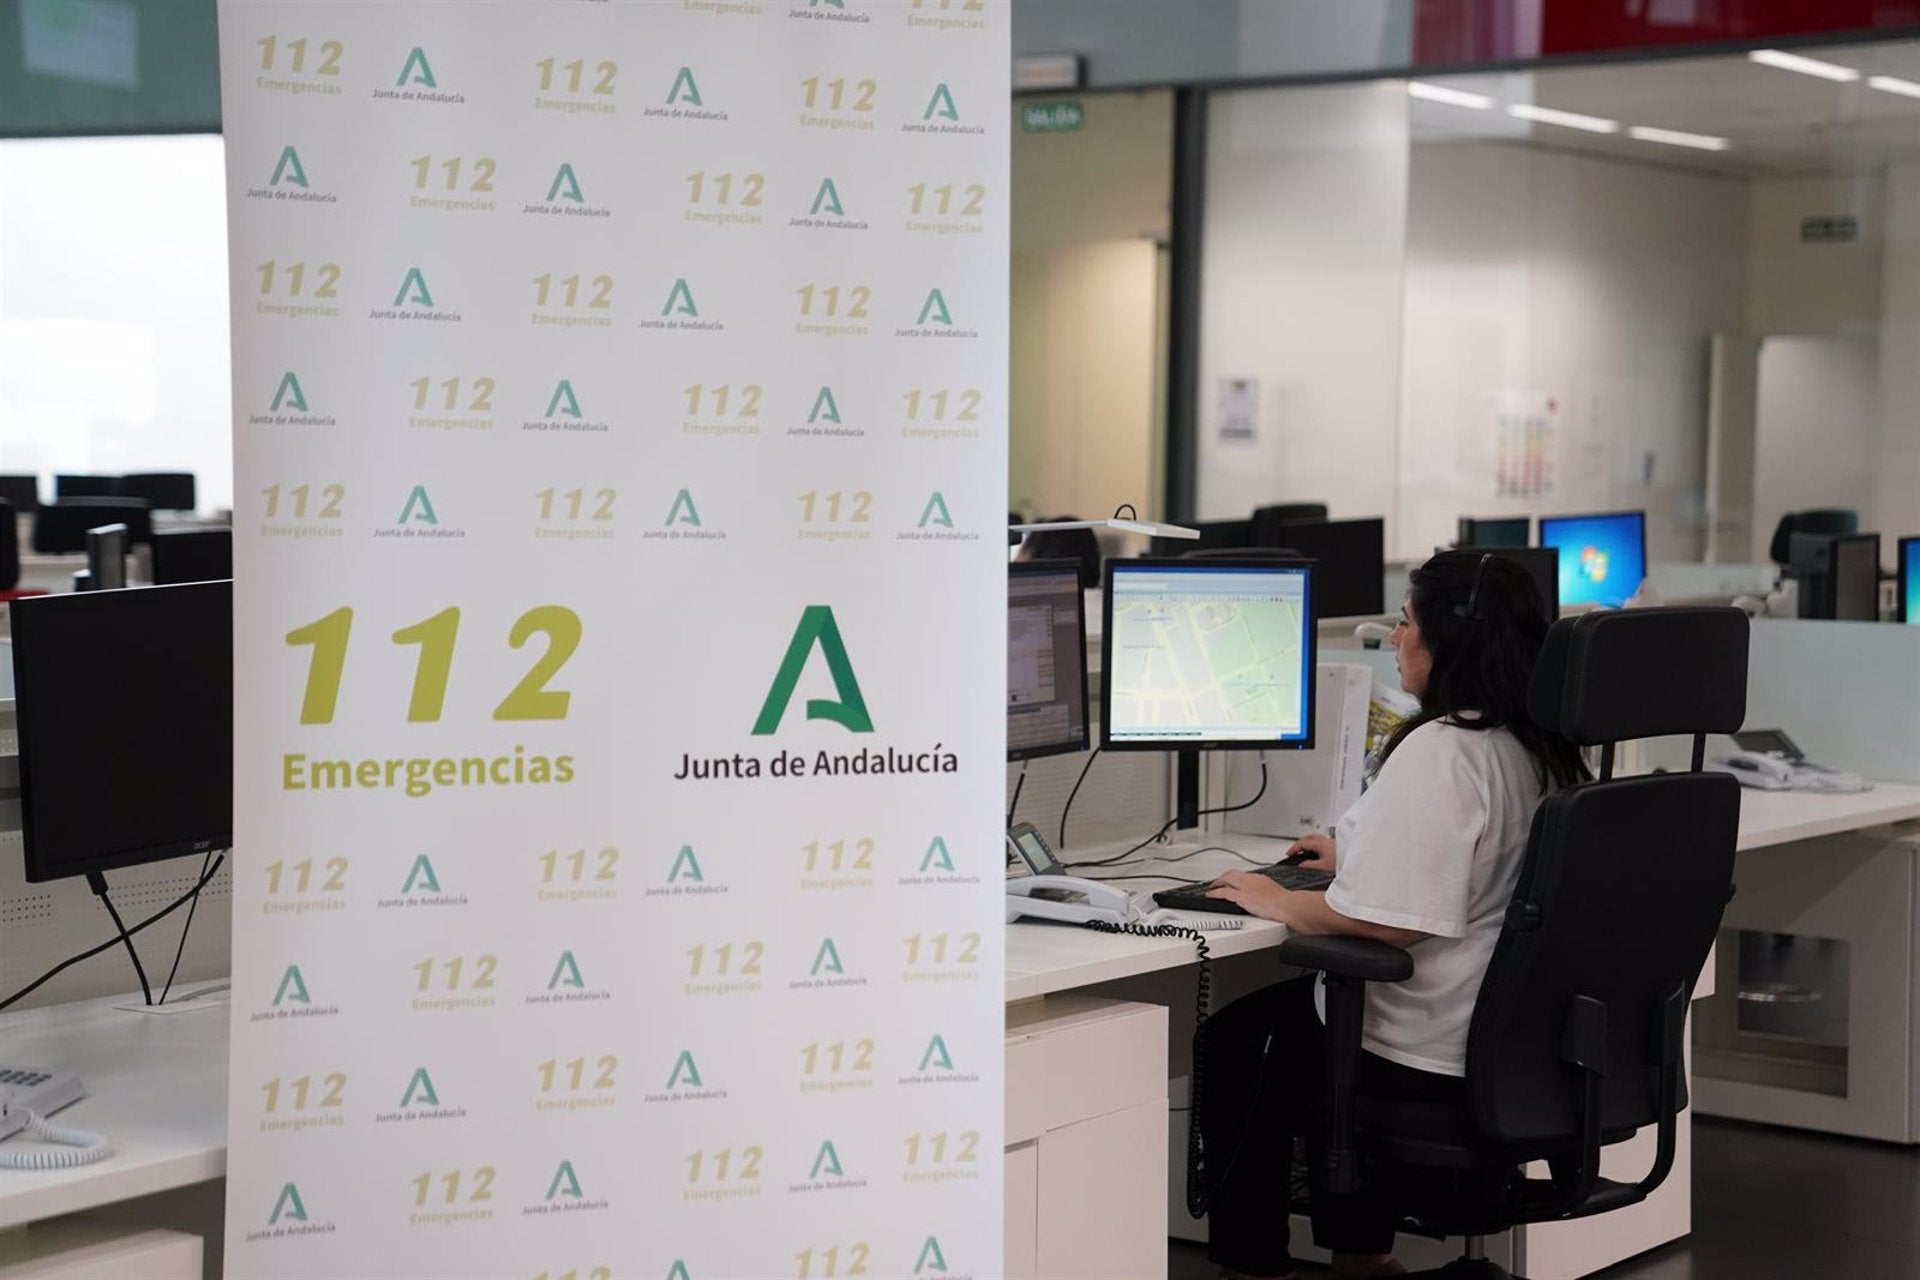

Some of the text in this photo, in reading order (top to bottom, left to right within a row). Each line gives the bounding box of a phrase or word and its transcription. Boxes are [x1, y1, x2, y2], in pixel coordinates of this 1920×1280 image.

[788, 10, 812, 19] Junta
[814, 11, 824, 19] de
[907, 15, 984, 30] Emergencias
[256, 35, 344, 75] 112
[535, 58, 618, 95] 112
[257, 77, 342, 95] Emergencias
[373, 89, 399, 99] Junta
[401, 90, 414, 100] de
[801, 77, 877, 111] 112
[535, 98, 616, 114] Emergencias
[644, 108, 668, 117] Junta
[670, 109, 681, 118] de
[800, 115, 874, 131] Emergencias
[902, 124, 925, 132] Junta
[928, 124, 938, 133] de
[411, 156, 497, 192] 112
[247, 189, 272, 199] Junta
[275, 190, 287, 200] de
[686, 171, 765, 205] 112
[411, 197, 495, 212] Emergencias
[908, 184, 985, 215] 112
[523, 205, 549, 214] Junta
[551, 206, 562, 214] de
[684, 210, 762, 225] Emergencias
[789, 218, 812, 227] Junta
[815, 219, 824, 227] de
[906, 221, 983, 234] Emergencias
[258, 261, 341, 297] 112
[532, 274, 613, 308] 112
[797, 285, 871, 318] 112
[257, 303, 339, 317] Emergencias
[370, 310, 396, 319] Junta
[398, 311, 411, 319] de
[532, 314, 612, 327] Emergencias
[639, 320, 664, 329] Junta
[667, 320, 677, 329] de
[796, 324, 868, 337] Emergencias
[922, 329, 931, 337] de
[410, 377, 495, 410] 112
[684, 384, 763, 417] 112
[903, 389, 982, 420] 112
[249, 415, 274, 424] Junta
[277, 416, 287, 425] de
[409, 417, 493, 430] Emergencias
[522, 422, 547, 430] Junta
[550, 422, 560, 431] de
[683, 423, 759, 436] Emergencias
[813, 428, 821, 436] de
[902, 426, 979, 440] Emergencias
[262, 484, 345, 517] 112
[535, 488, 617, 520] 112
[798, 491, 872, 522] 112
[262, 526, 343, 539] Emergencias
[374, 529, 401, 537] Junta
[404, 529, 415, 537] de
[535, 527, 614, 540] Emergencias
[669, 531, 680, 539] de
[798, 528, 870, 541] Emergencias
[896, 532, 920, 540] Junta
[922, 532, 933, 540] de
[285, 605, 583, 724] 112
[674, 743, 958, 780] Junta de Andalucía
[284, 745, 574, 798] Emergencias
[801, 838, 874, 871] 112
[539, 847, 620, 882] 112
[264, 855, 348, 894] 112
[898, 877, 921, 885] Junta
[924, 876, 934, 884] de
[801, 876, 872, 890] Emergencias
[538, 886, 617, 902] Emergencias
[645, 887, 669, 896] Junta
[671, 887, 682, 895] de
[263, 898, 346, 915] Emergencias
[377, 899, 403, 908] Junta
[405, 897, 418, 907] de
[904, 932, 981, 964] 112
[687, 941, 764, 976] 112
[413, 955, 498, 991] 112
[903, 970, 979, 984] Emergencias
[685, 980, 762, 996] Emergencias
[788, 981, 812, 989] Junta
[814, 979, 824, 988] de
[412, 996, 495, 1011] Emergencias
[524, 995, 549, 1004] Junta
[552, 994, 563, 1002] de
[250, 1010, 275, 1022] Junta
[278, 1009, 289, 1019] de
[801, 1038, 874, 1074] 112
[537, 1055, 618, 1093] 112
[898, 1076, 921, 1084] Junta
[924, 1075, 934, 1083] de
[261, 1073, 347, 1112] 112
[800, 1078, 873, 1093] Emergencias
[536, 1096, 616, 1112] Emergencias
[644, 1094, 668, 1104] Junta
[670, 1093, 681, 1101] de
[259, 1115, 344, 1133] Emergencias
[375, 1112, 402, 1123] Junta
[405, 1110, 416, 1120] de
[904, 1130, 981, 1164] 112
[685, 1145, 763, 1182] 112
[903, 1169, 978, 1183] Emergencias
[411, 1166, 497, 1205] 112
[788, 1182, 811, 1193] Junta
[814, 1182, 823, 1190] de
[683, 1186, 760, 1202] Emergencias
[522, 1205, 547, 1215] Junta
[550, 1202, 561, 1212] de
[410, 1209, 493, 1226] Emergencias
[245, 1231, 271, 1242] Junta
[273, 1227, 285, 1238] de
[795, 1242, 870, 1280] 112
